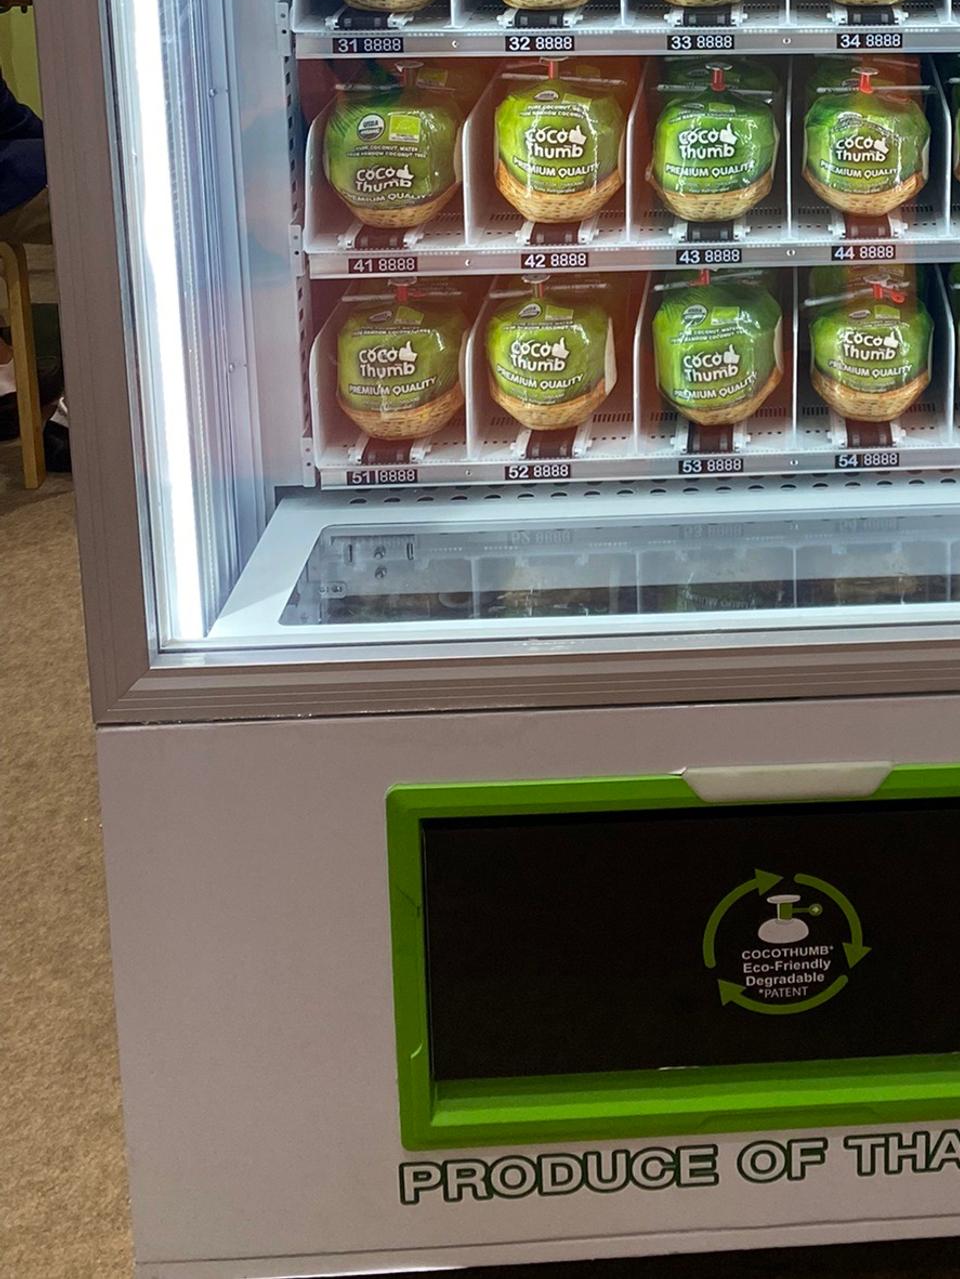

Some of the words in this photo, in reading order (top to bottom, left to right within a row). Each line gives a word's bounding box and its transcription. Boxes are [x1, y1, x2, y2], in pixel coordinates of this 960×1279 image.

[509, 37, 531, 51] 32
[840, 34, 861, 48] 34
[679, 143, 735, 160] Thumb
[665, 163, 709, 178] PREMIUM
[524, 254, 546, 269] 42
[510, 354, 566, 372] Thumb
[497, 364, 537, 388] PREMIUM
[539, 373, 584, 390] QUALITY
[838, 454, 858, 468] 54
[743, 959, 832, 974] Eco-Friendly
[745, 972, 825, 988] Degradable
[399, 1144, 719, 1204] PRODUCE
[737, 1137, 829, 1183] OF
